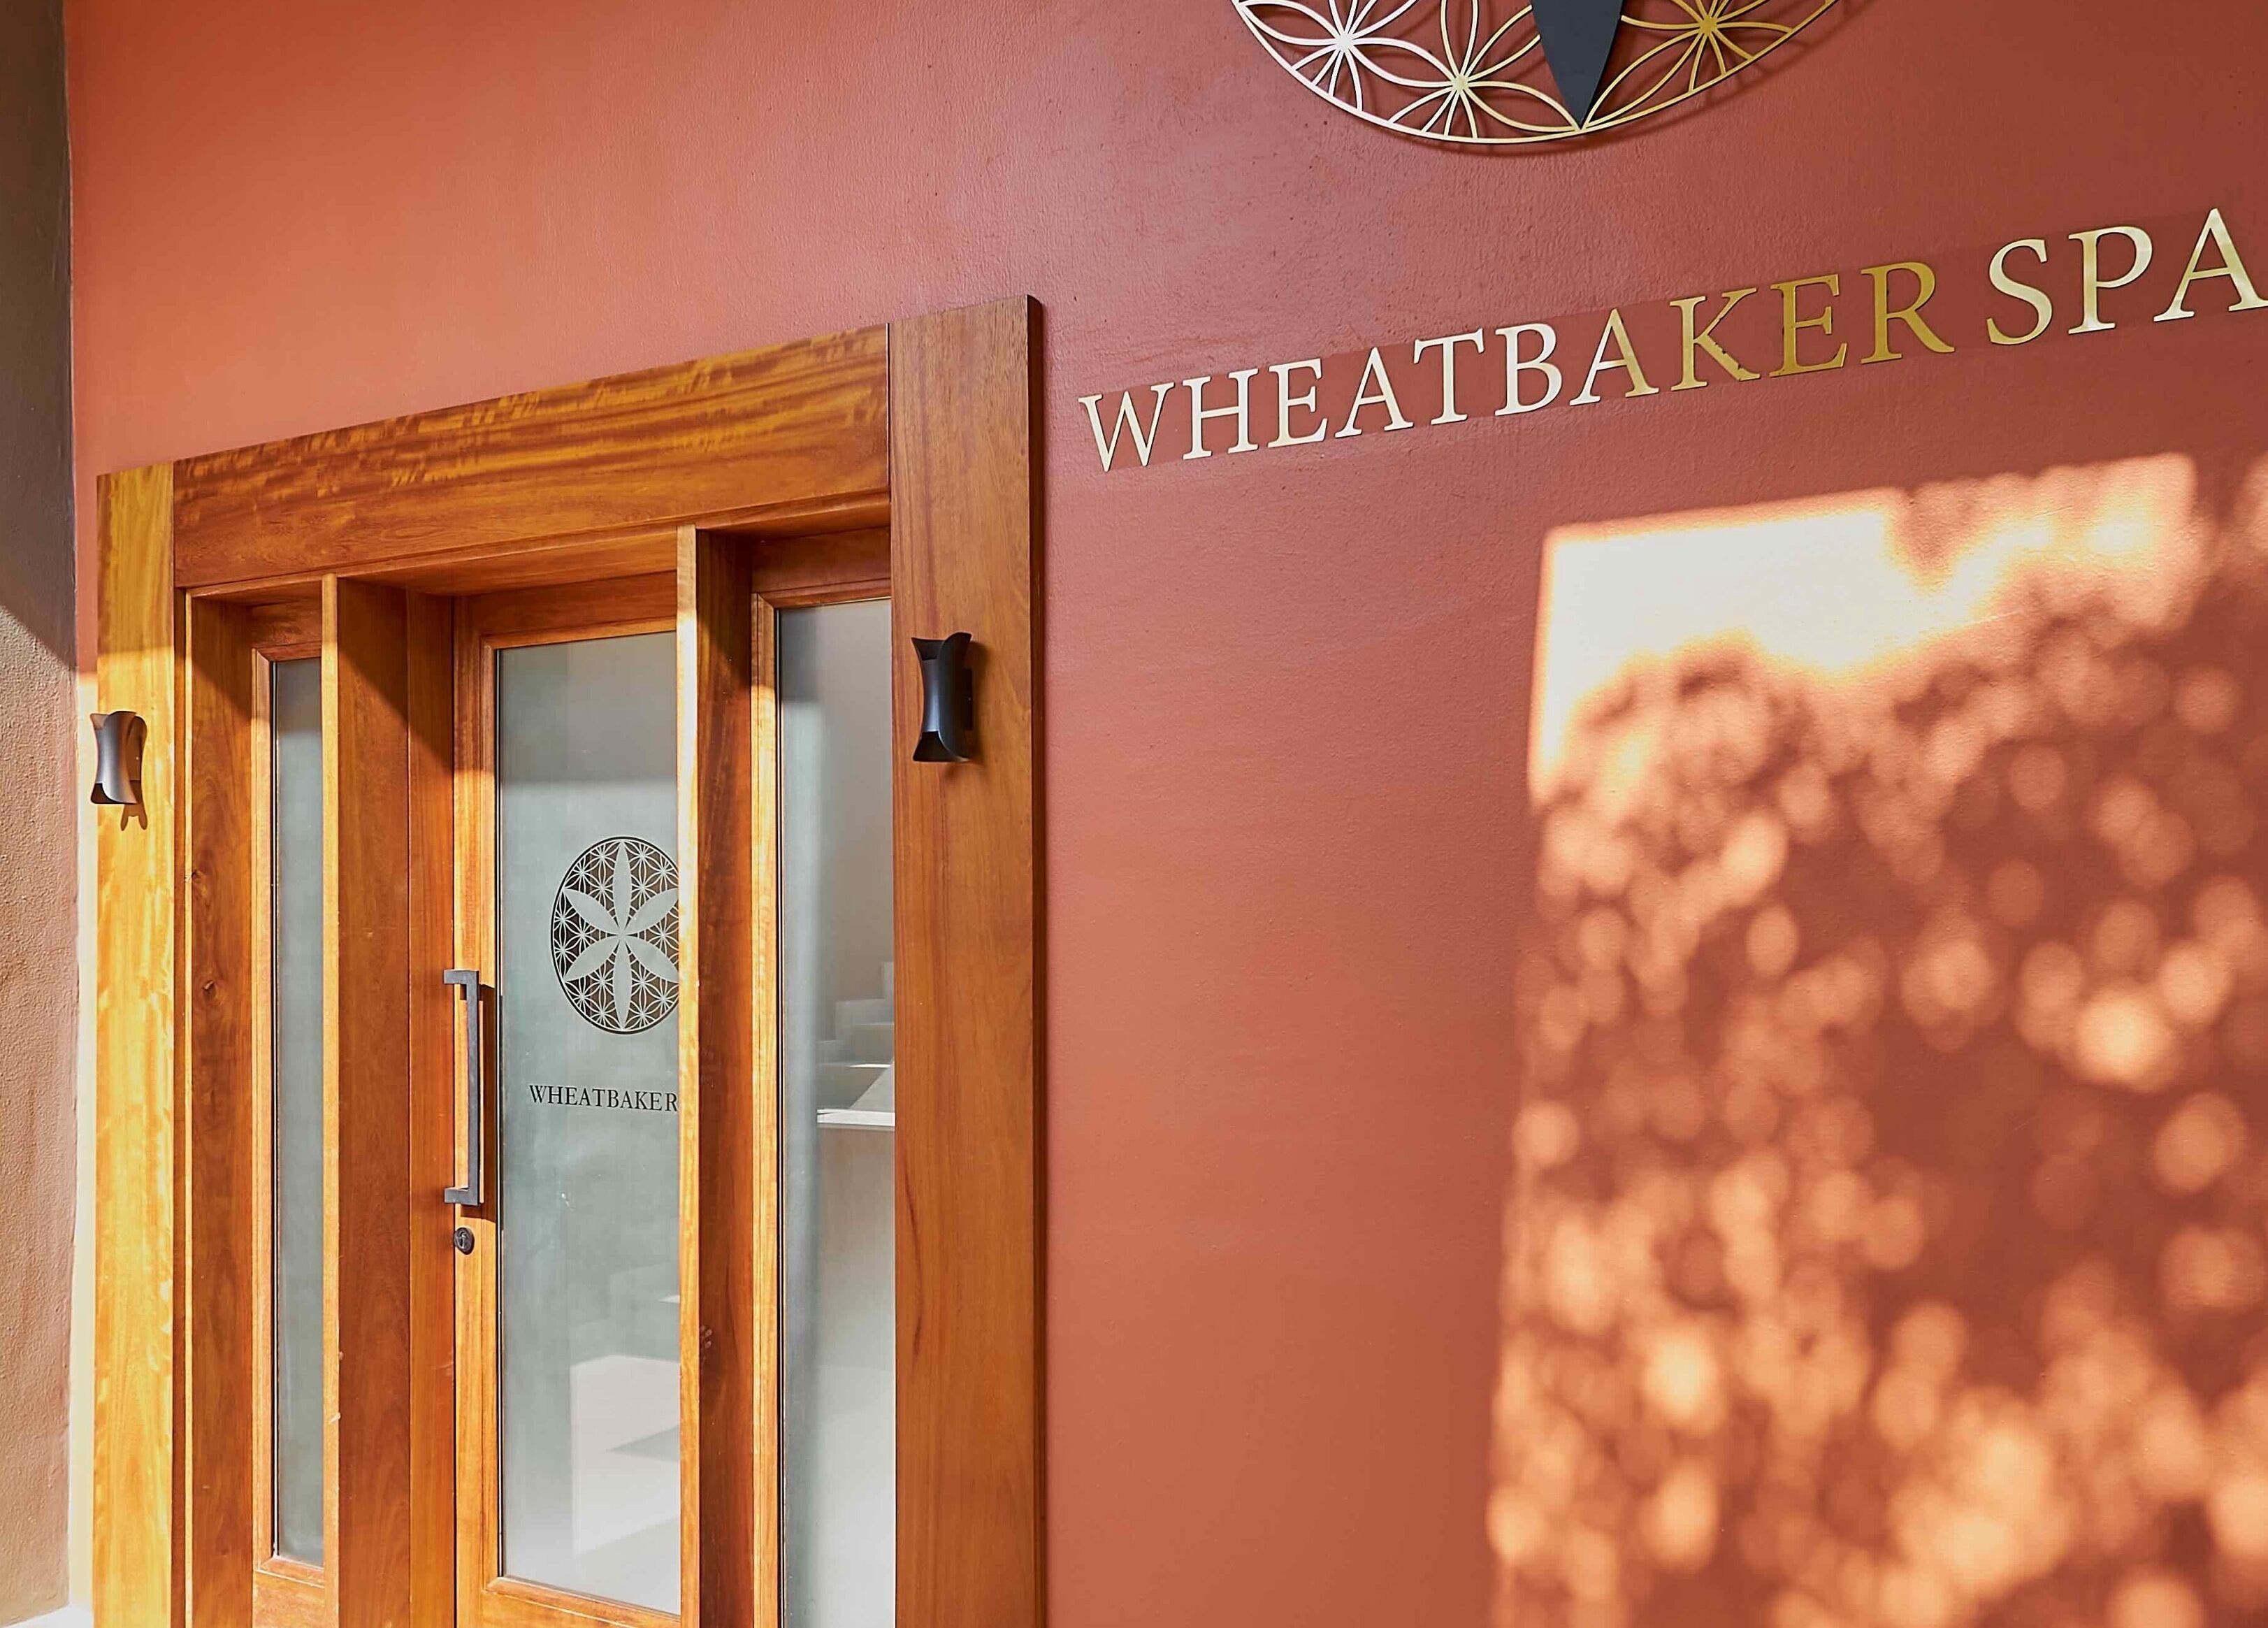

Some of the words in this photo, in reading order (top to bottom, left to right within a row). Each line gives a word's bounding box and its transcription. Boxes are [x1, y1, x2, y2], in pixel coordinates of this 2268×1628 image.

[1078, 261, 1955, 472] WHEATBAKER
[1985, 208, 2268, 345] SPA
[529, 1085, 678, 1111] WHEATBAKER
